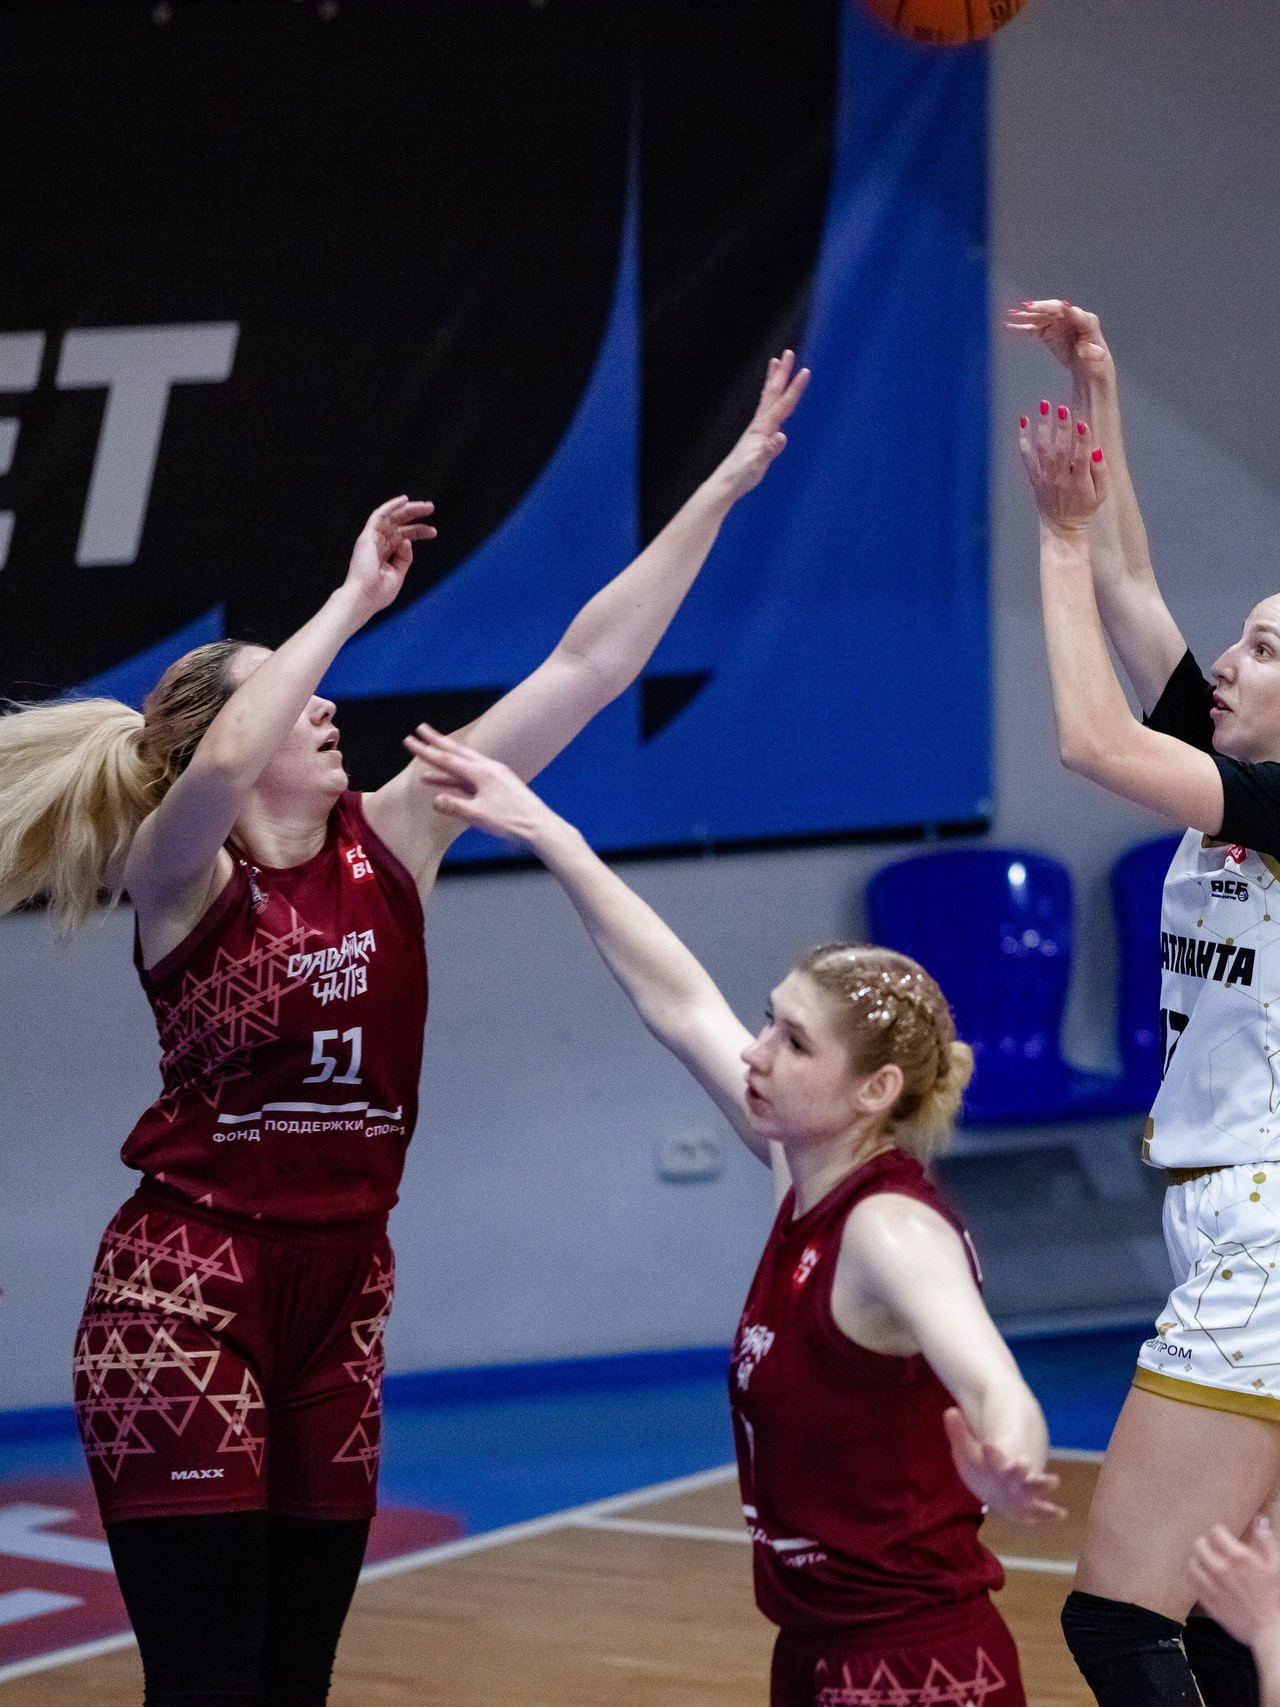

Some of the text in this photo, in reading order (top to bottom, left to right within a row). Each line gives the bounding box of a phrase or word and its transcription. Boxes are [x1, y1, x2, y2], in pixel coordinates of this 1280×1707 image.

[1160, 931, 1256, 987] АТЛАНТА
[302, 1026, 363, 1085] 51
[212, 1128, 260, 1143] ФОНД
[264, 1119, 363, 1135] ПОДДЕРЖКИ
[170, 1468, 225, 1481] MAXX
